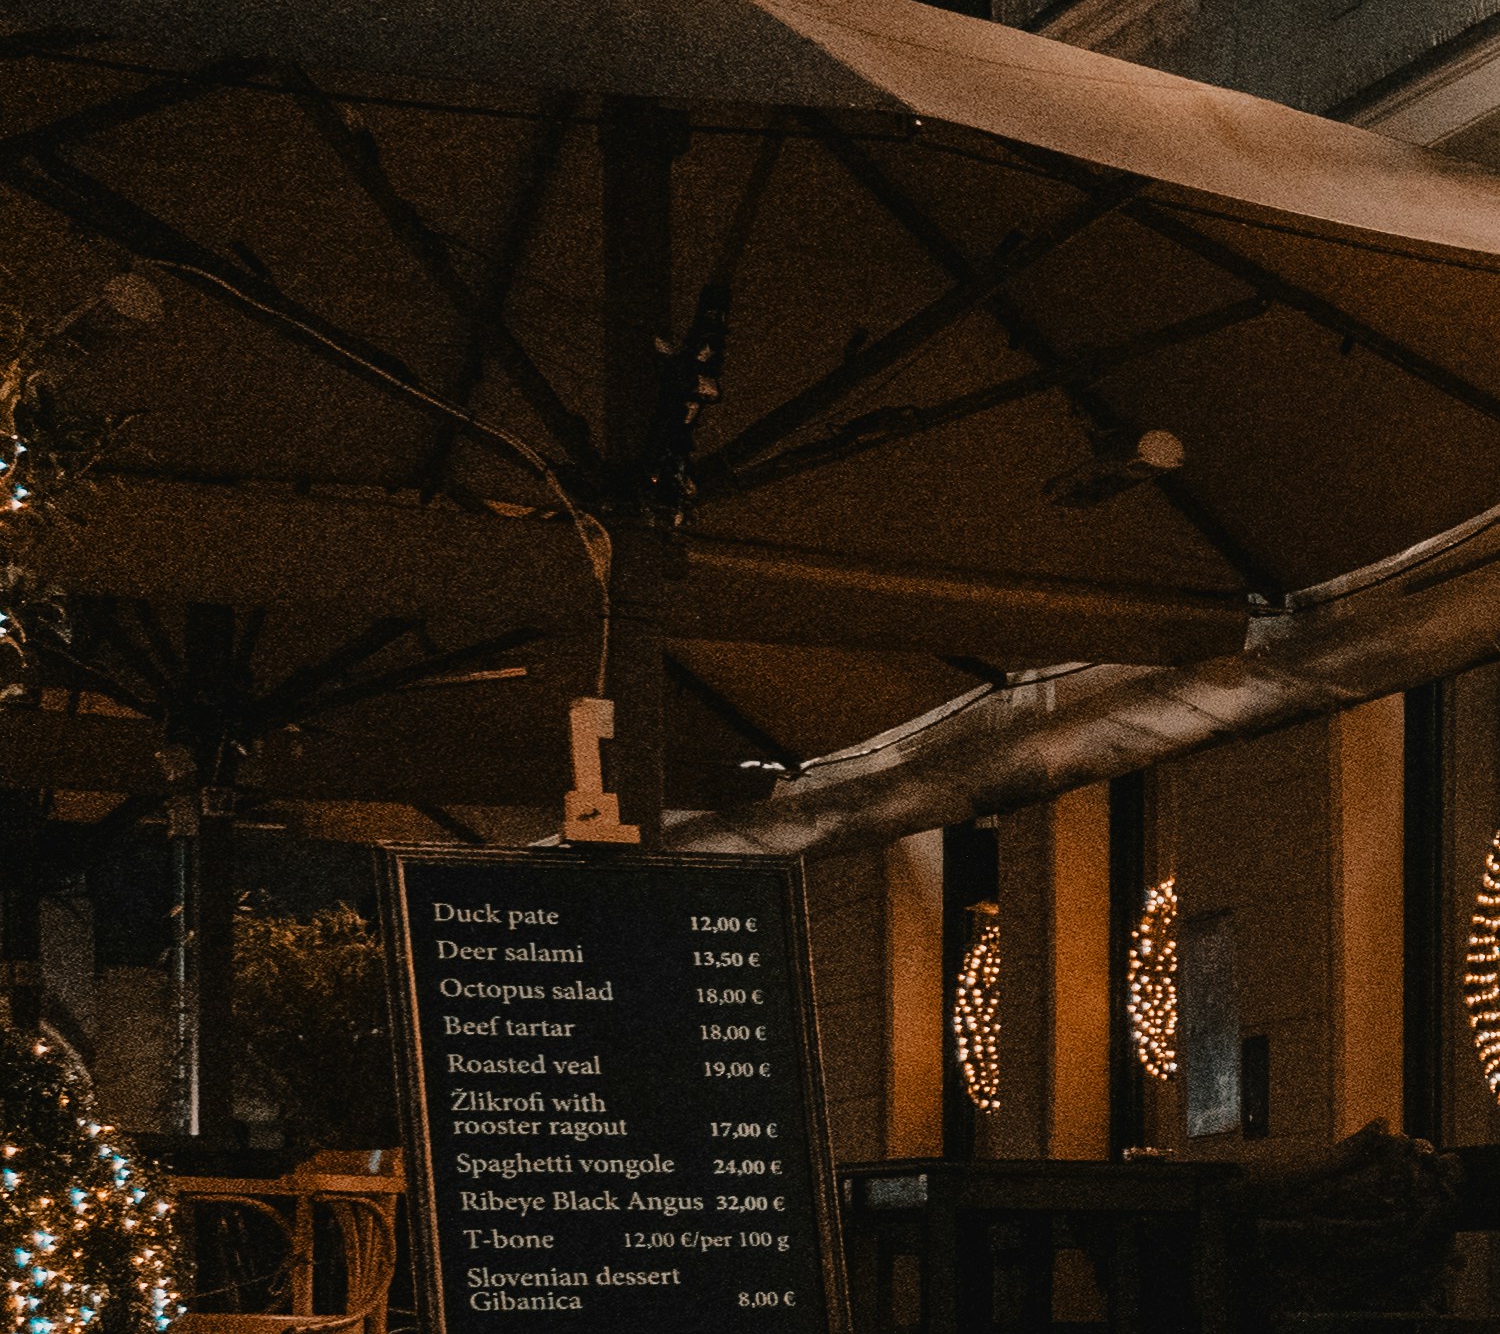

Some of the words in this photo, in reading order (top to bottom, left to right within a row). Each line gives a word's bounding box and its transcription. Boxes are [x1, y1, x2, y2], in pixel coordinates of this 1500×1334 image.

[433, 902, 502, 924] Duck
[508, 909, 560, 931] pate
[690, 915, 741, 934] 12,00
[744, 917, 758, 933] €
[436, 940, 498, 961] Deer
[504, 941, 584, 964] salami
[693, 951, 744, 969] 13,50
[747, 951, 761, 968] €
[439, 978, 546, 1005] Octopus
[551, 980, 614, 1002] salad
[696, 987, 747, 1006] 18,00
[751, 989, 764, 1005] €
[443, 1015, 501, 1036] Beef
[505, 1019, 576, 1038] tartar
[700, 1024, 751, 1042] 18,00
[754, 1025, 767, 1042] €
[447, 1053, 547, 1075] Roasted
[552, 1055, 602, 1075] veal
[704, 1061, 755, 1079] 19,00
[758, 1062, 771, 1078] €
[450, 1088, 545, 1112] Žlikrofi
[551, 1092, 607, 1113] with
[453, 1118, 542, 1135] rooster
[548, 1119, 628, 1142] ragout
[710, 1121, 762, 1140] 17,00
[765, 1122, 778, 1139] €
[456, 1152, 573, 1180] Spaghetti
[578, 1153, 675, 1180] vongole
[713, 1158, 766, 1177] 24,00
[769, 1160, 783, 1175] €
[460, 1190, 546, 1218] Ribeye
[552, 1190, 621, 1211] Black
[627, 1191, 705, 1217] Angus
[716, 1195, 769, 1213] 32,00
[772, 1195, 786, 1212] €
[462, 1228, 555, 1250] T-bone
[624, 1232, 676, 1250] 12,00
[739, 1231, 773, 1248] 100
[776, 1235, 790, 1252] g
[467, 1266, 589, 1288] Slovenian
[595, 1265, 681, 1286] dessert
[469, 1290, 583, 1312] Gibanica
[738, 1291, 779, 1309] 8,00
[783, 1290, 796, 1307] €
